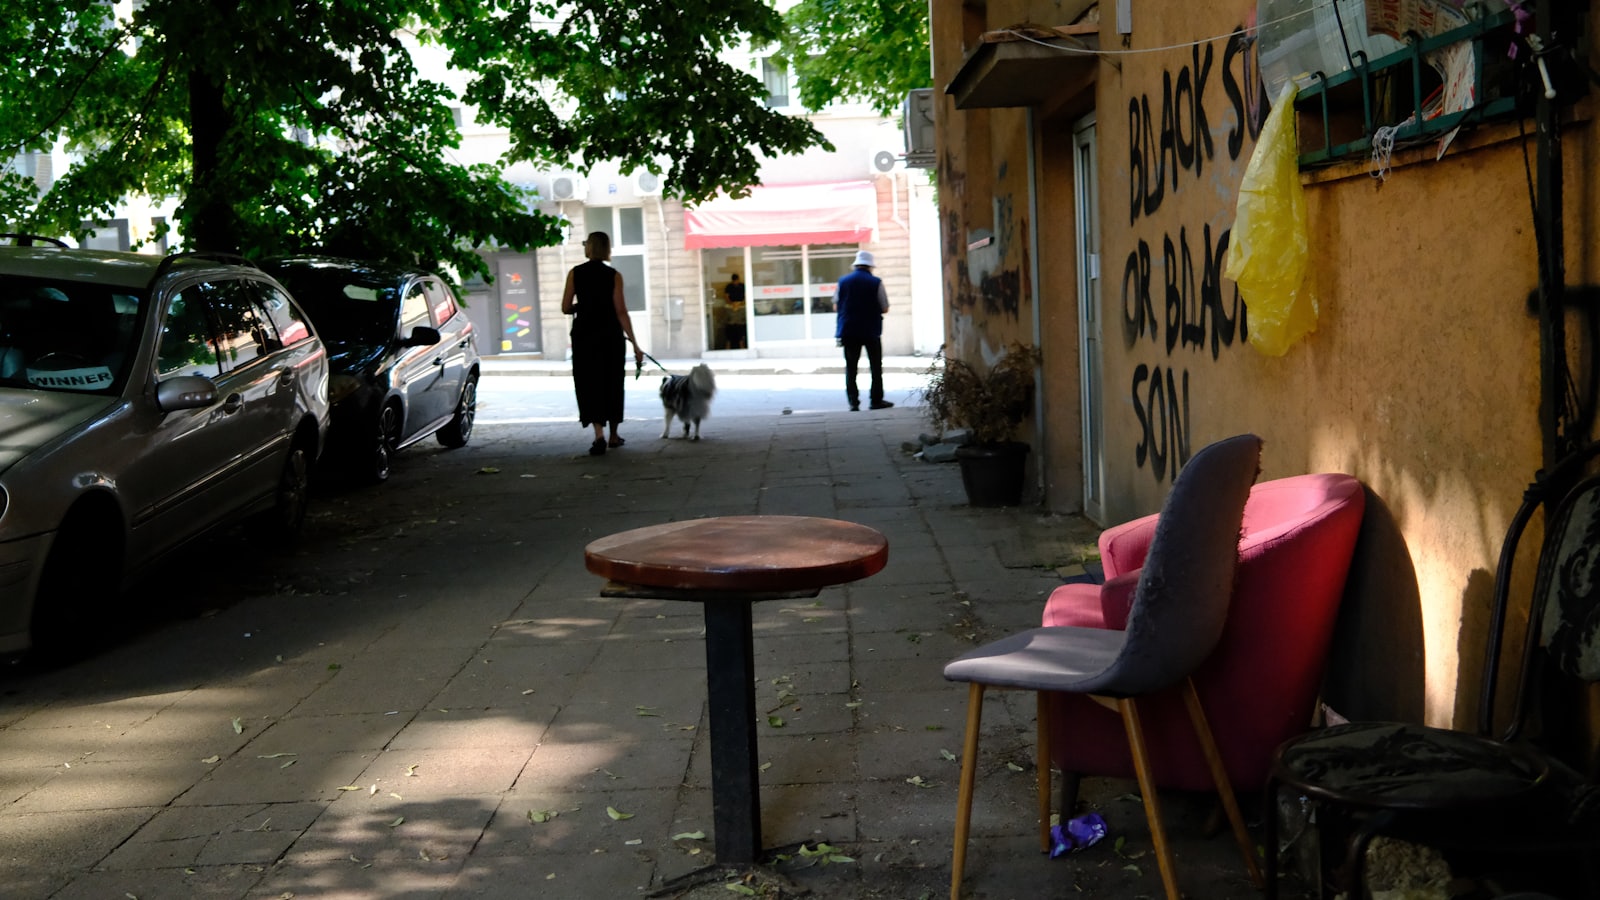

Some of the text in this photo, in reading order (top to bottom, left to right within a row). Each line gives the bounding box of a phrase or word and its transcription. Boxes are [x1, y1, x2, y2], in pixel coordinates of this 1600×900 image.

[1122, 237, 1158, 353] OR
[30, 372, 112, 386] WINNER
[1132, 363, 1190, 484] SON
